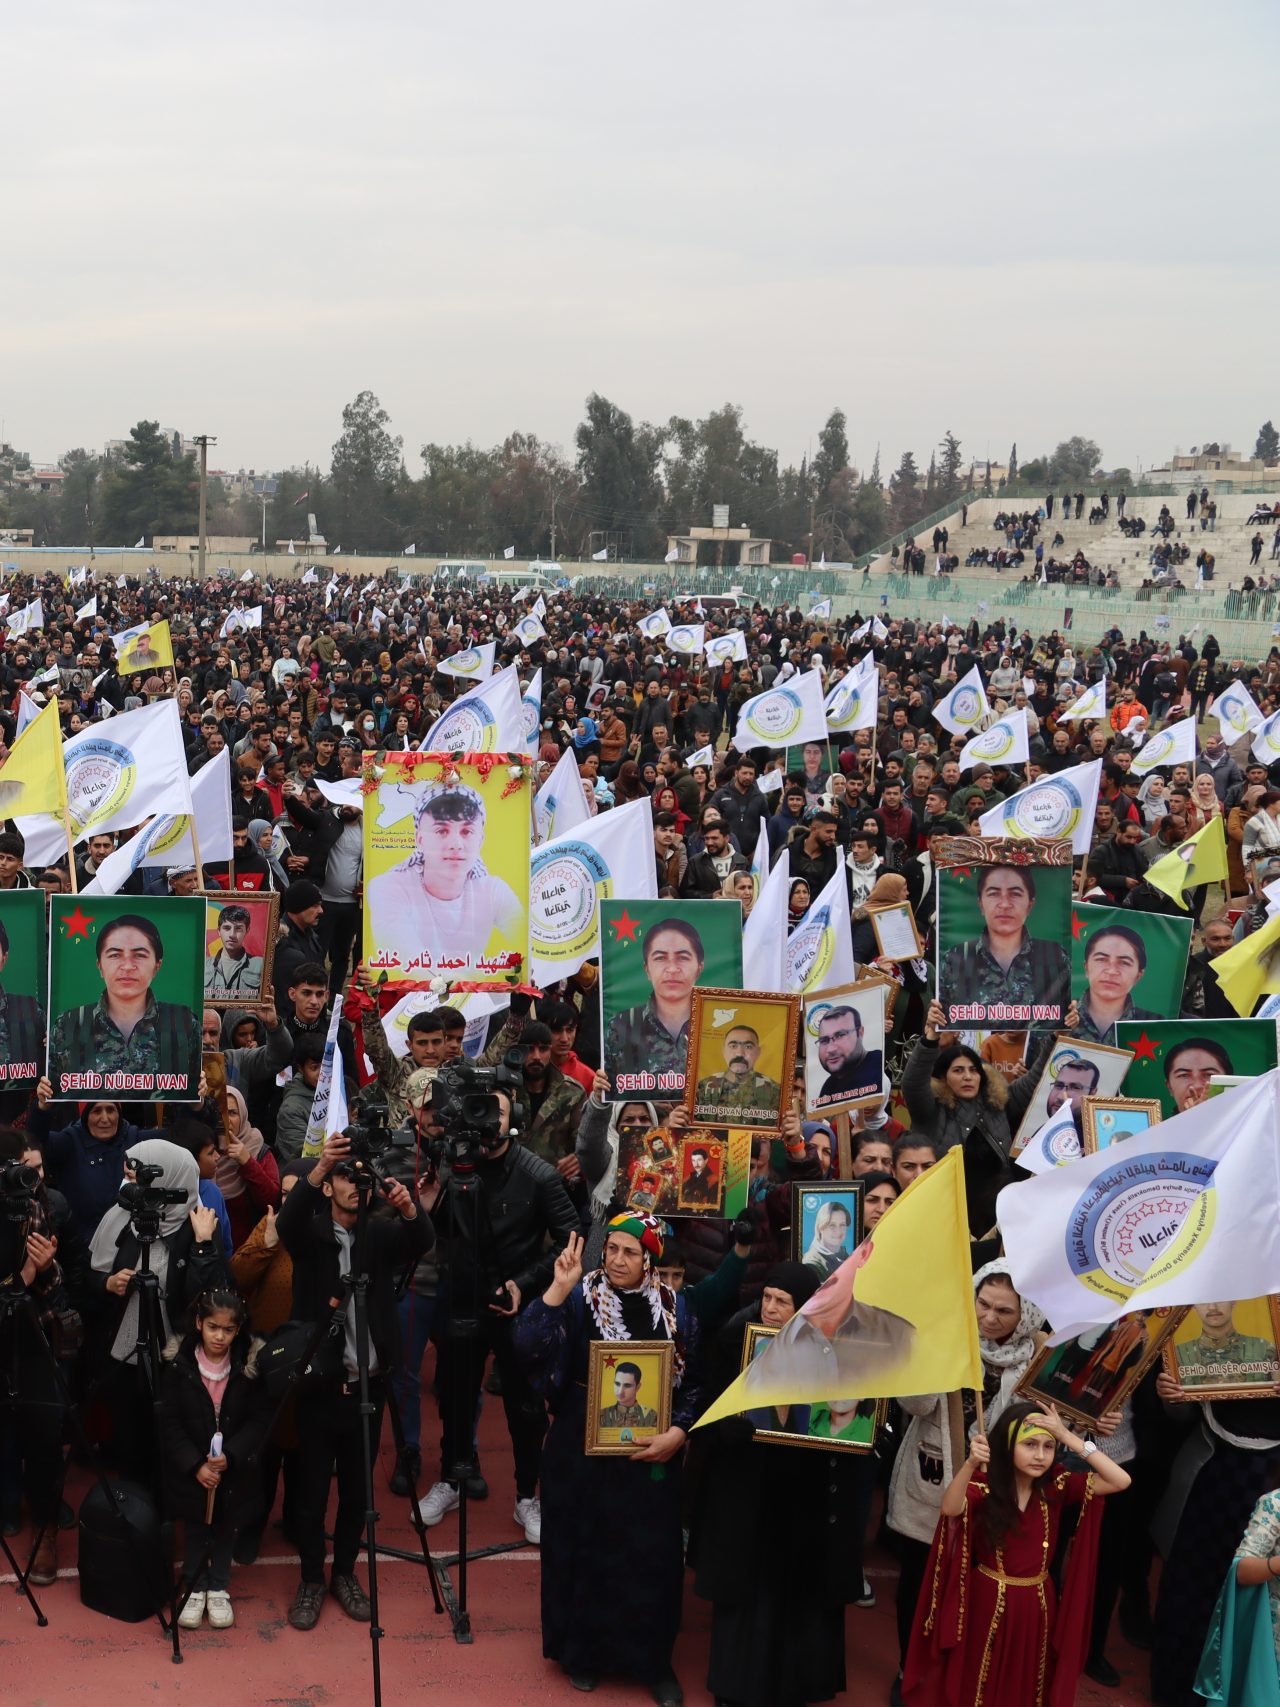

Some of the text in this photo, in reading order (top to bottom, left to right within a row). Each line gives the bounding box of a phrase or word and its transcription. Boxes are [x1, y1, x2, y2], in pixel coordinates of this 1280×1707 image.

[369, 949, 513, 974] شهيد احمد ثامر خلف
[949, 1001, 1061, 1024] ŞEHÎD NÛDEM WAN
[9, 1061, 37, 1079] WAN
[60, 1070, 188, 1092] ŞEHÎD NÛDEM WAN
[616, 1069, 685, 1093] ŞEHÎD NÛD
